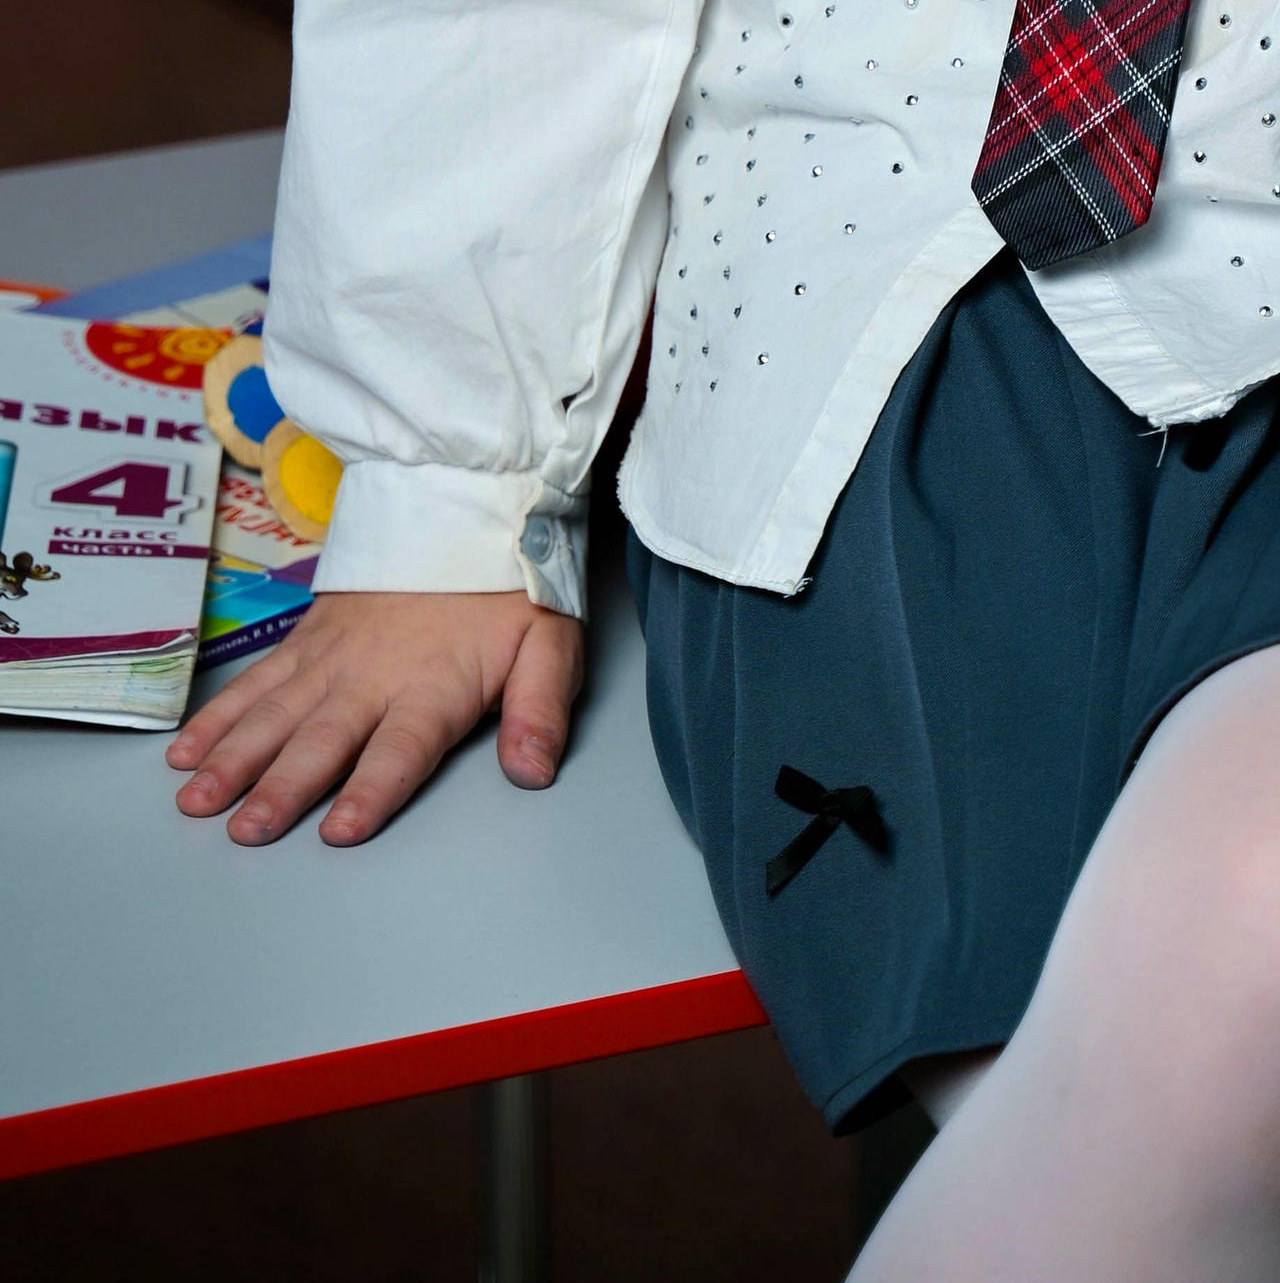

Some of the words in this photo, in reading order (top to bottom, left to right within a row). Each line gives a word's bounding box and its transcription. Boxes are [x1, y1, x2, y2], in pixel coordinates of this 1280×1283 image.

[51, 460, 183, 518] 4
[53, 526, 178, 542] класс
[61, 543, 153, 556] часть
[162, 545, 176, 557] 1
